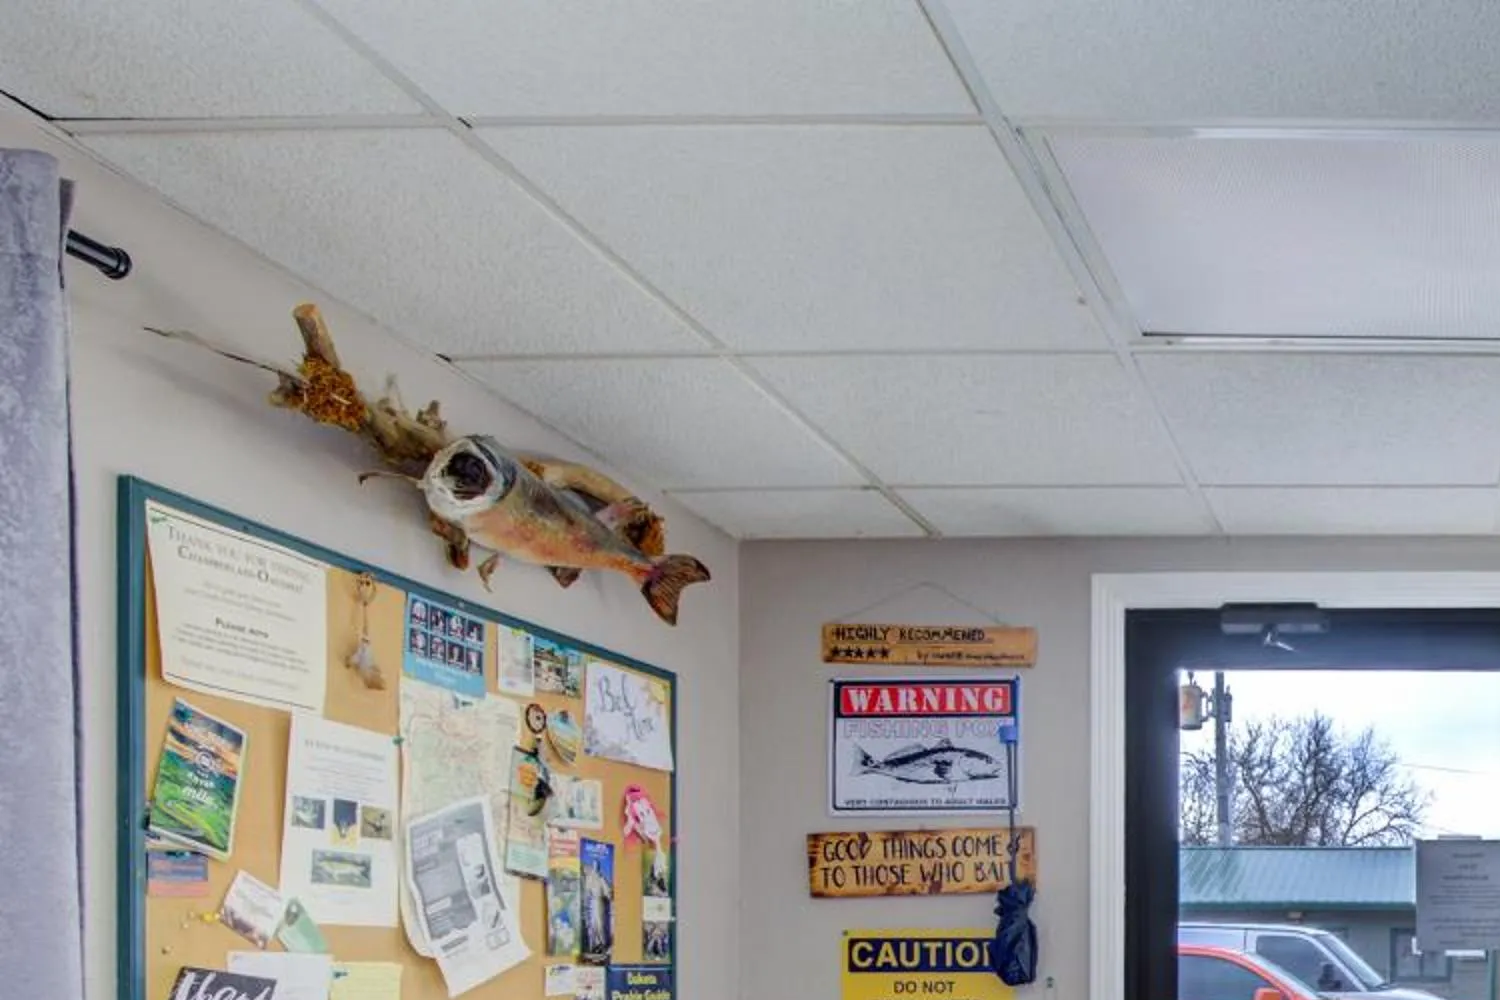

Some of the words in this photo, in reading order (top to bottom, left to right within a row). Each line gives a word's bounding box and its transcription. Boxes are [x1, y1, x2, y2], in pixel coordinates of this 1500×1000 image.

[832, 625, 890, 641] HIGHLY
[848, 687, 1004, 712] WARNING
[843, 718, 947, 739] FISHING
[823, 836, 872, 862] GOOD
[880, 837, 946, 860] THINGS
[951, 834, 1002, 858] COME
[820, 867, 846, 889] TO
[851, 863, 912, 887] THOSE
[919, 861, 965, 884] WHO
[893, 981, 917, 994] DO
[922, 981, 956, 994] NOT
